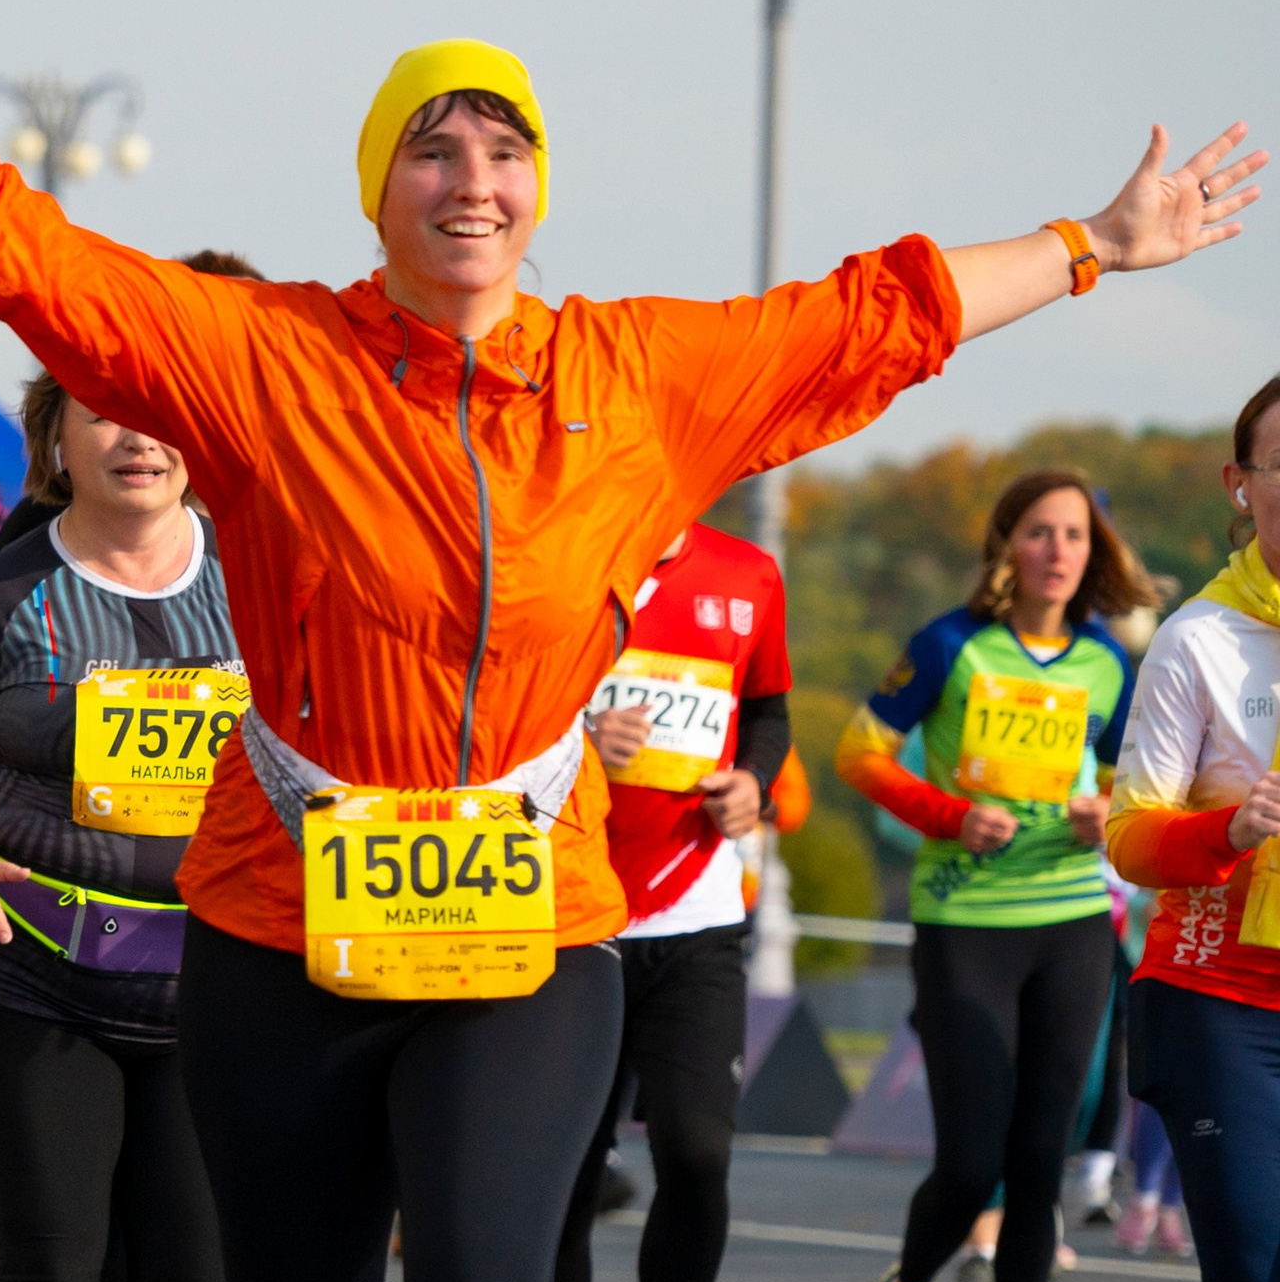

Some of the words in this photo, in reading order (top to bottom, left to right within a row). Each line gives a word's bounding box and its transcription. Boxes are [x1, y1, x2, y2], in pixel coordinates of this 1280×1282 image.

[1244, 697, 1274, 719] GRi
[103, 707, 238, 759] 7578
[977, 709, 1079, 751] 17209
[131, 765, 206, 781] НАТАЛЬЯ
[88, 786, 113, 816] G
[321, 833, 542, 900] 15045
[385, 908, 477, 926] МАРИНА
